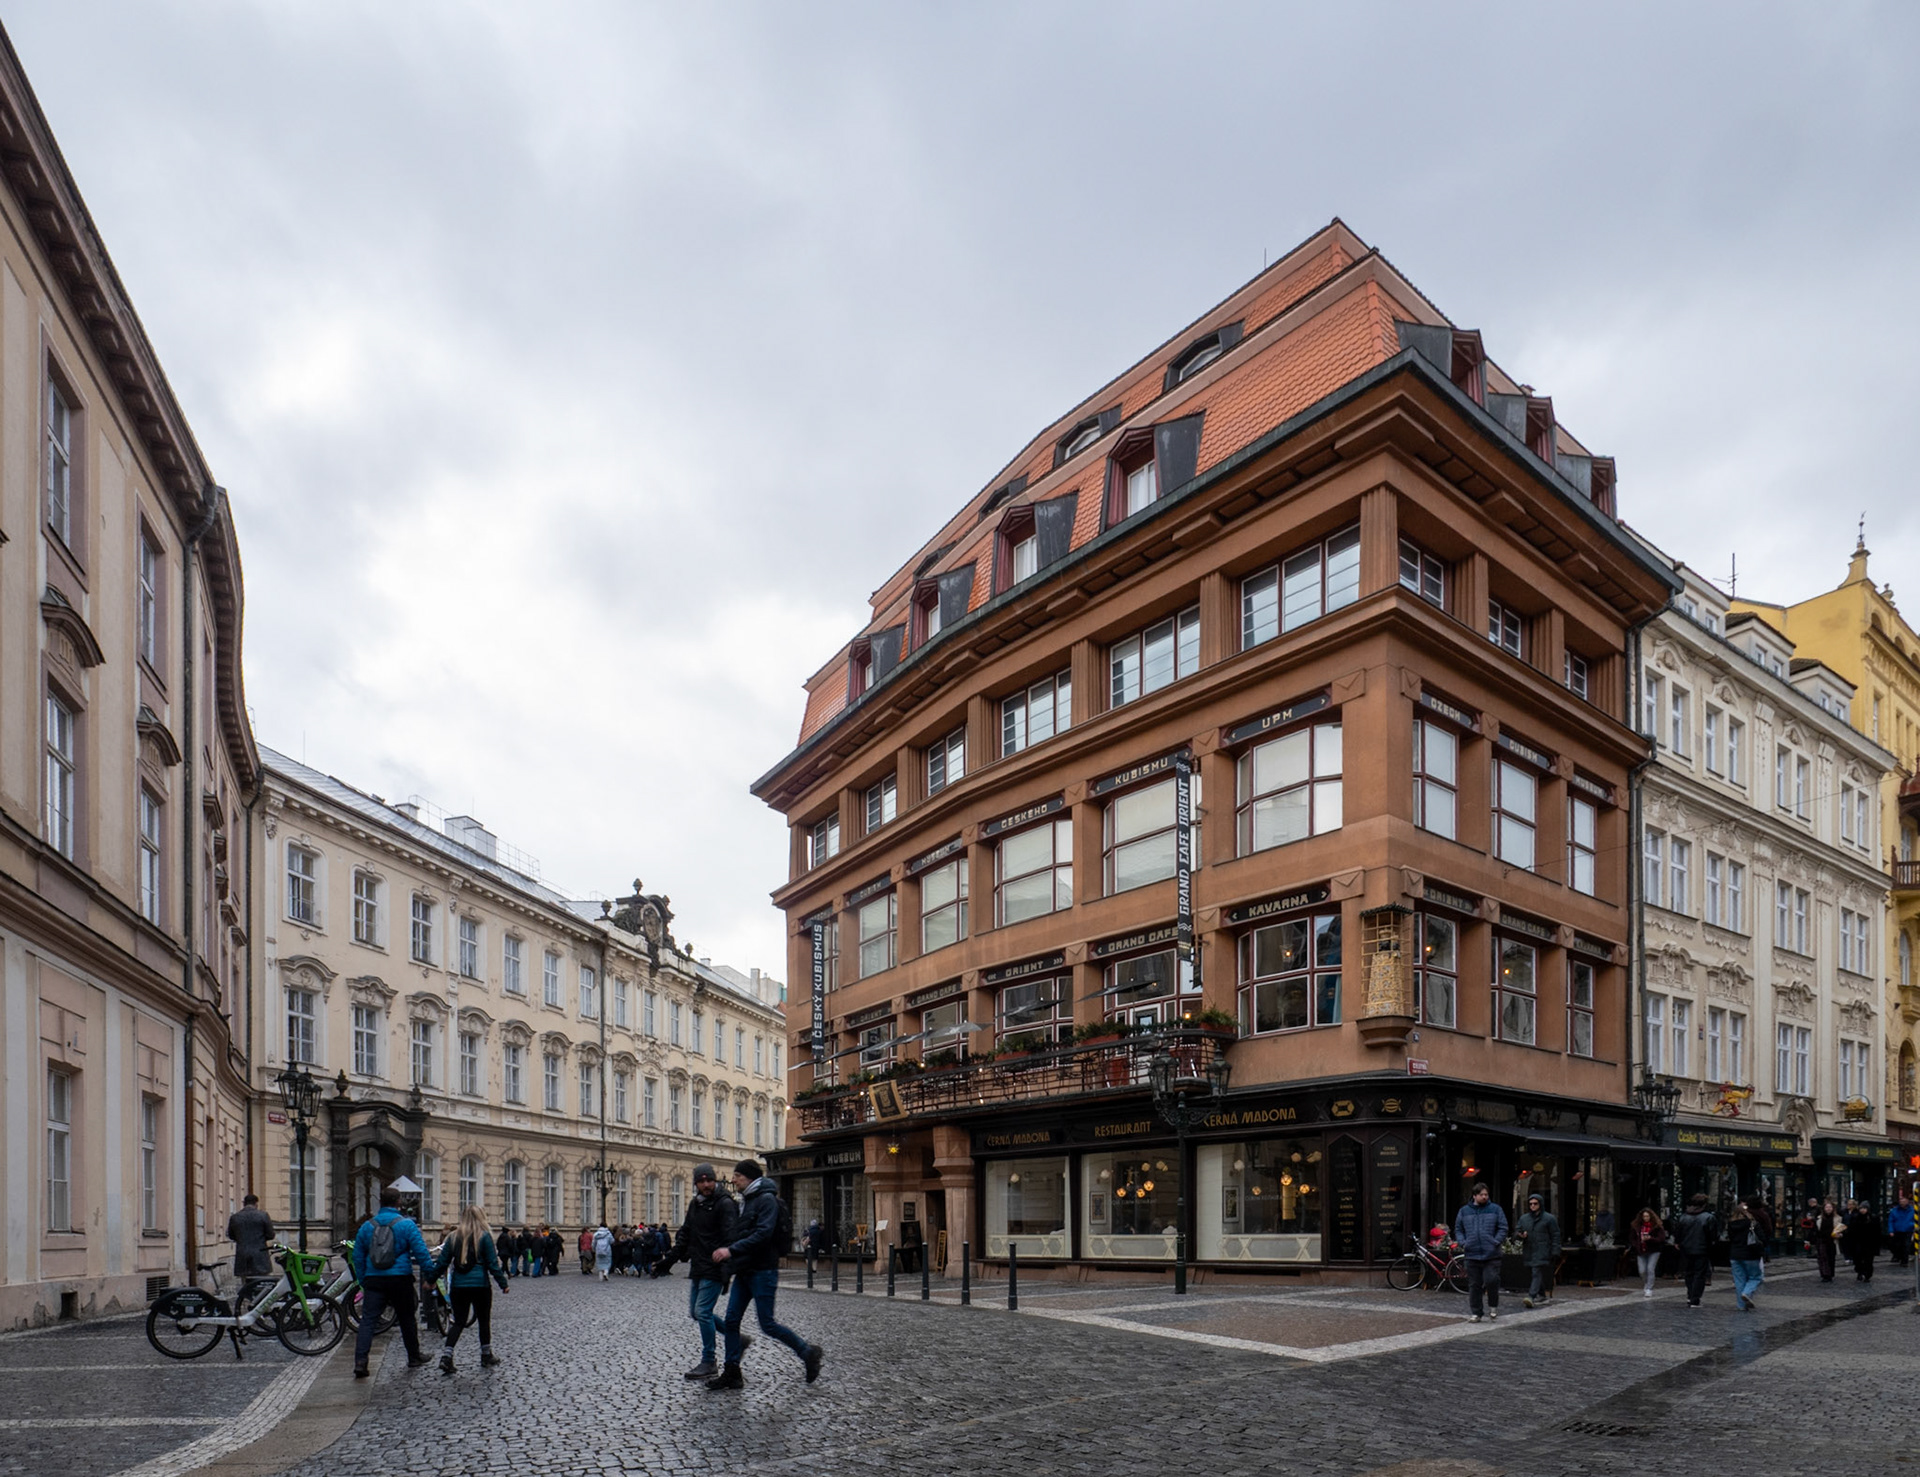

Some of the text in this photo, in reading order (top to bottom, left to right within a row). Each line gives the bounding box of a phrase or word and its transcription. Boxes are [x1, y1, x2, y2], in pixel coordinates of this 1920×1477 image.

[1262, 708, 1292, 729] UPM
[1115, 757, 1168, 785] KUBISMU
[1179, 778, 1189, 827] ORIENT
[1179, 869, 1190, 916] GRAND
[814, 924, 823, 991] KUBISMUS
[812, 997, 823, 1039] ČESKÝ
[1094, 1120, 1151, 1138] RESTAURANT
[1241, 1107, 1297, 1124] MADONA
[1012, 1131, 1051, 1146] MADONA
